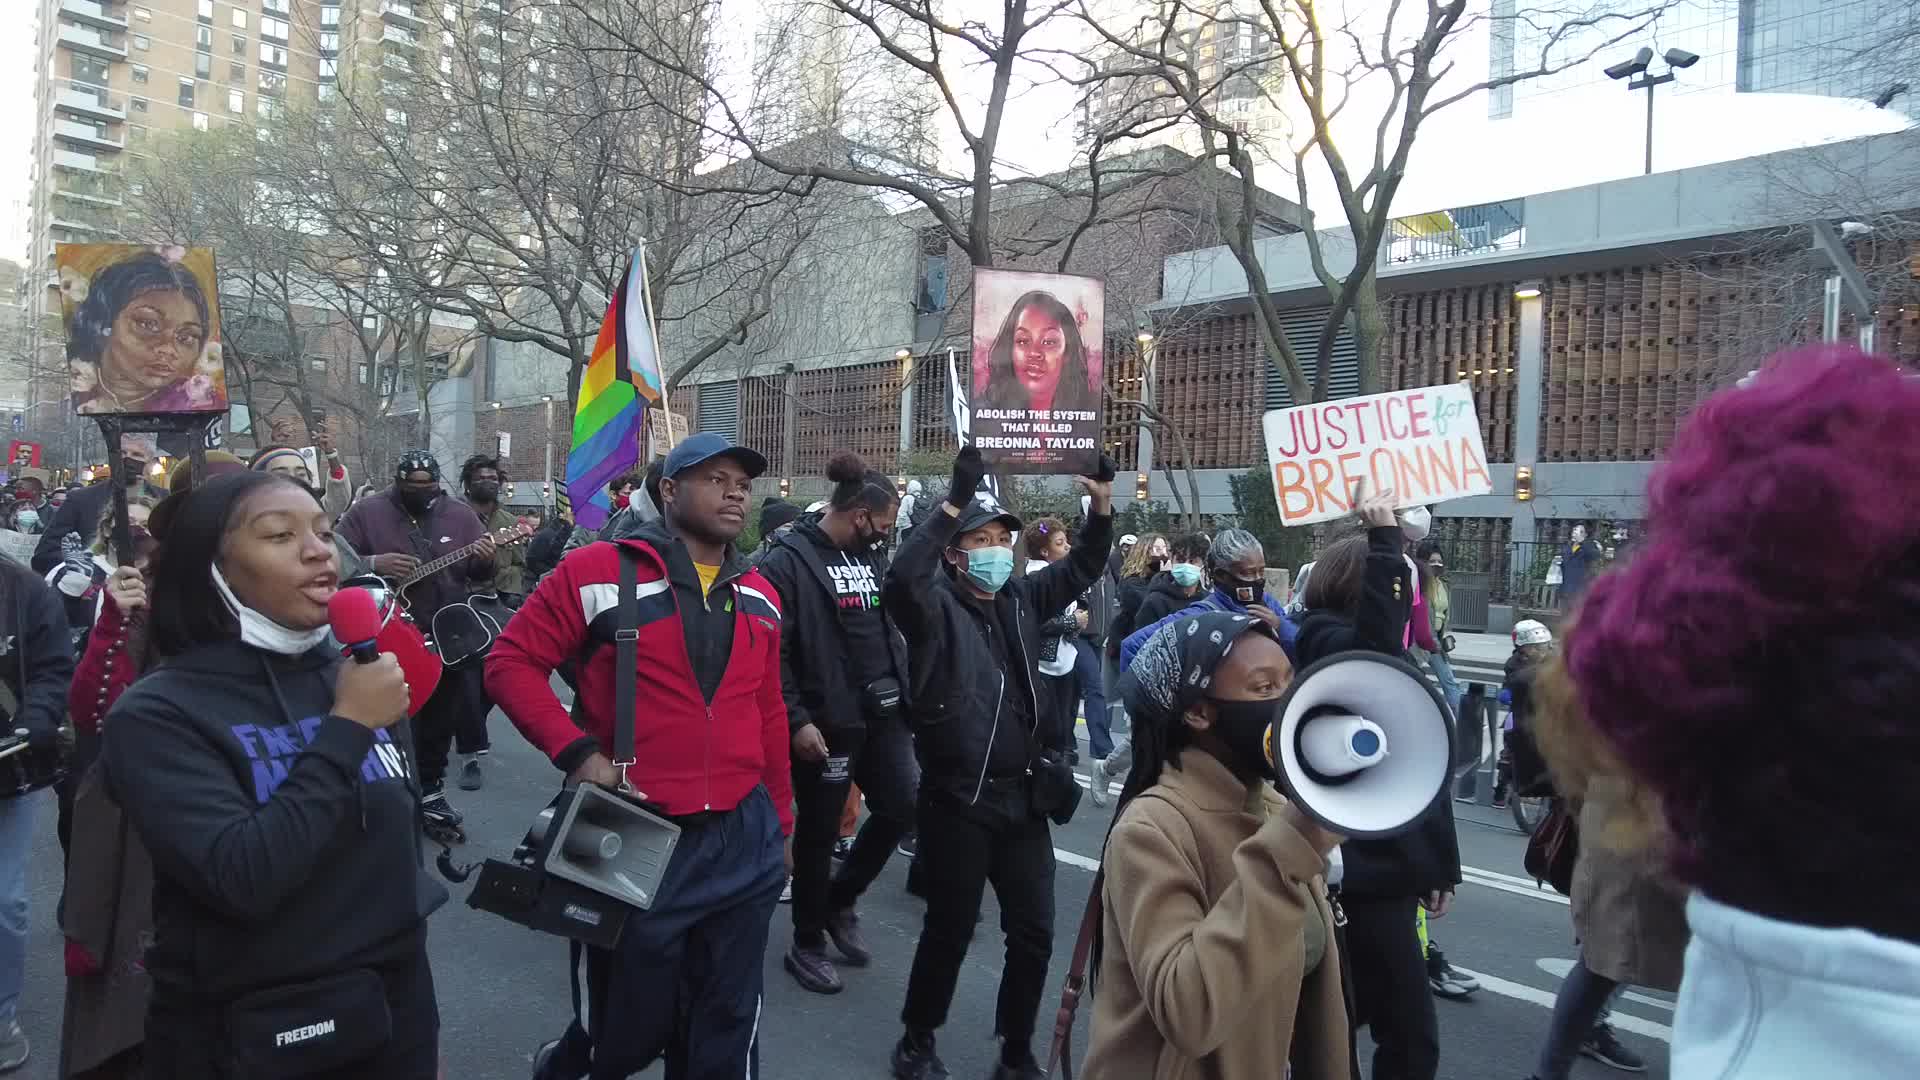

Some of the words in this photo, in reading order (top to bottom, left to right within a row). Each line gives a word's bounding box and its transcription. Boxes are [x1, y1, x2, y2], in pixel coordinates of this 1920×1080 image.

[976, 409, 1026, 419] ABOLISH
[1028, 410, 1051, 420] THE
[1053, 411, 1096, 420] SYSTEM
[1001, 423, 1031, 433] THAT
[1033, 423, 1073, 433] KILLED
[1279, 394, 1431, 457] JUSTICE
[1433, 396, 1470, 436] for
[976, 437, 1040, 449] BREONNA
[1045, 438, 1095, 449] TAYLOR
[1275, 437, 1493, 520] BREONNA
[276, 1019, 335, 1046] FREEDOM
